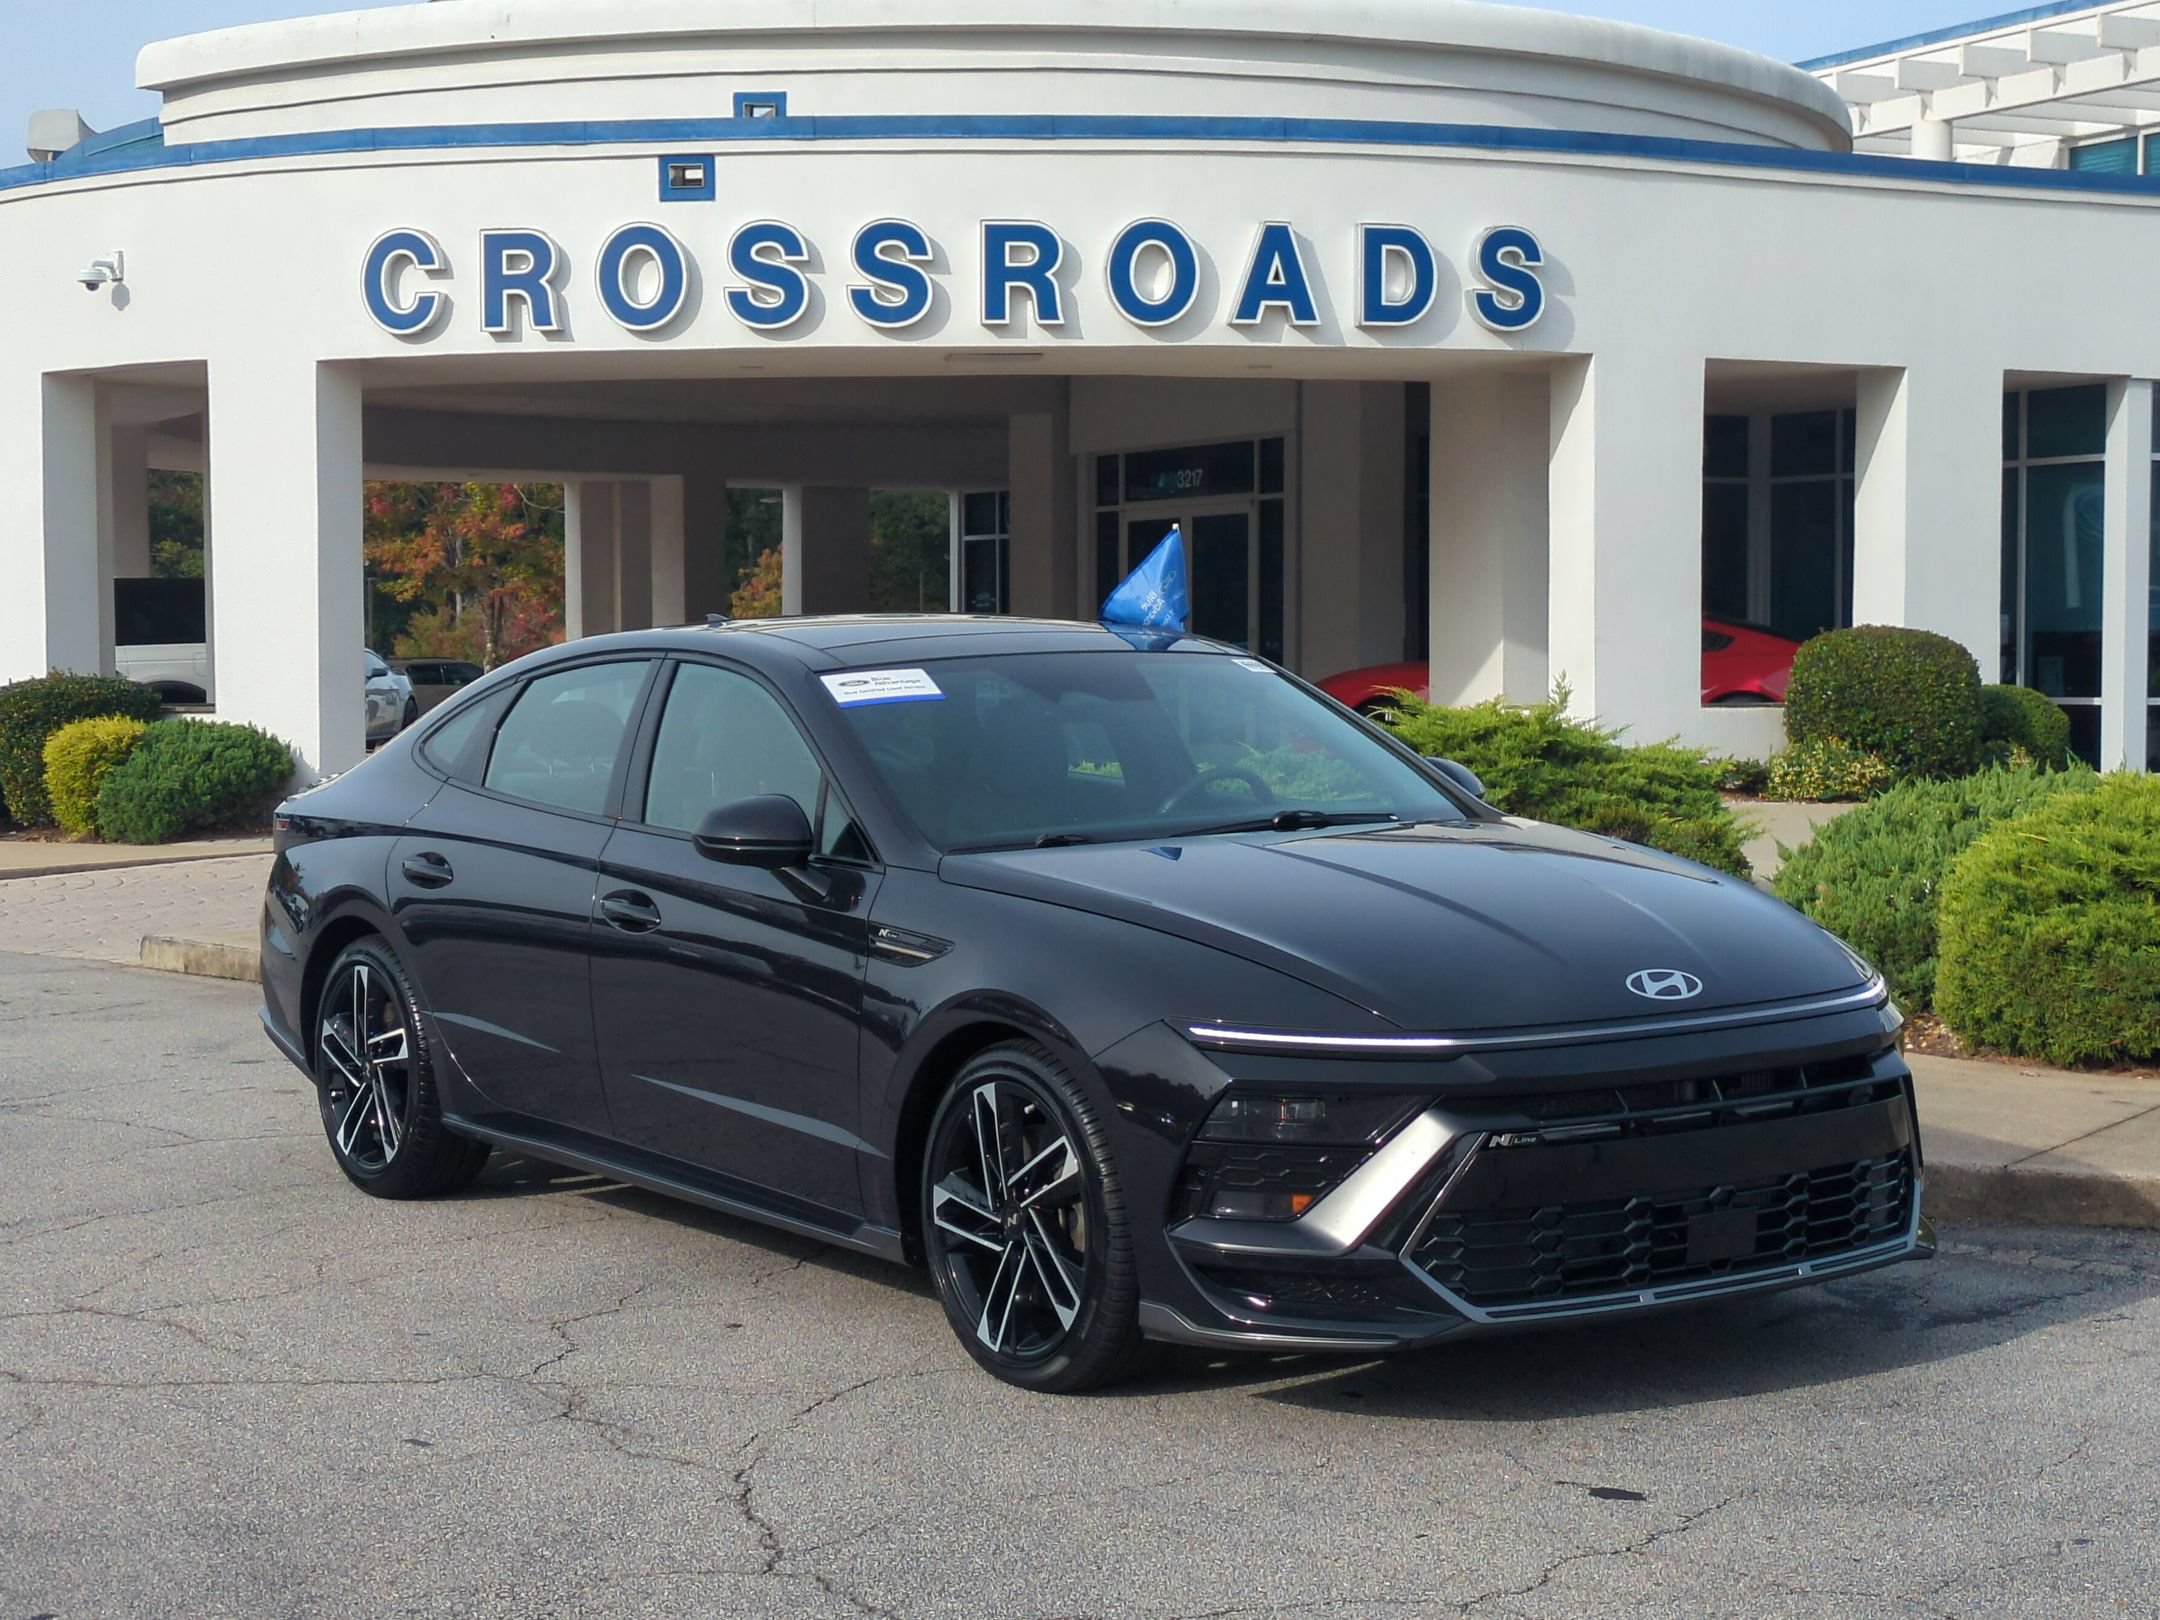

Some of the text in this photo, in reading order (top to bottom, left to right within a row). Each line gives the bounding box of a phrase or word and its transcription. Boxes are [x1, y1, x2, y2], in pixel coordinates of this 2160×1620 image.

[361, 217, 1545, 335] CROSSROADS
[1177, 468, 1203, 489] 3217
[1489, 1133, 1537, 1148] N Line
[1007, 1213, 1018, 1227] N
